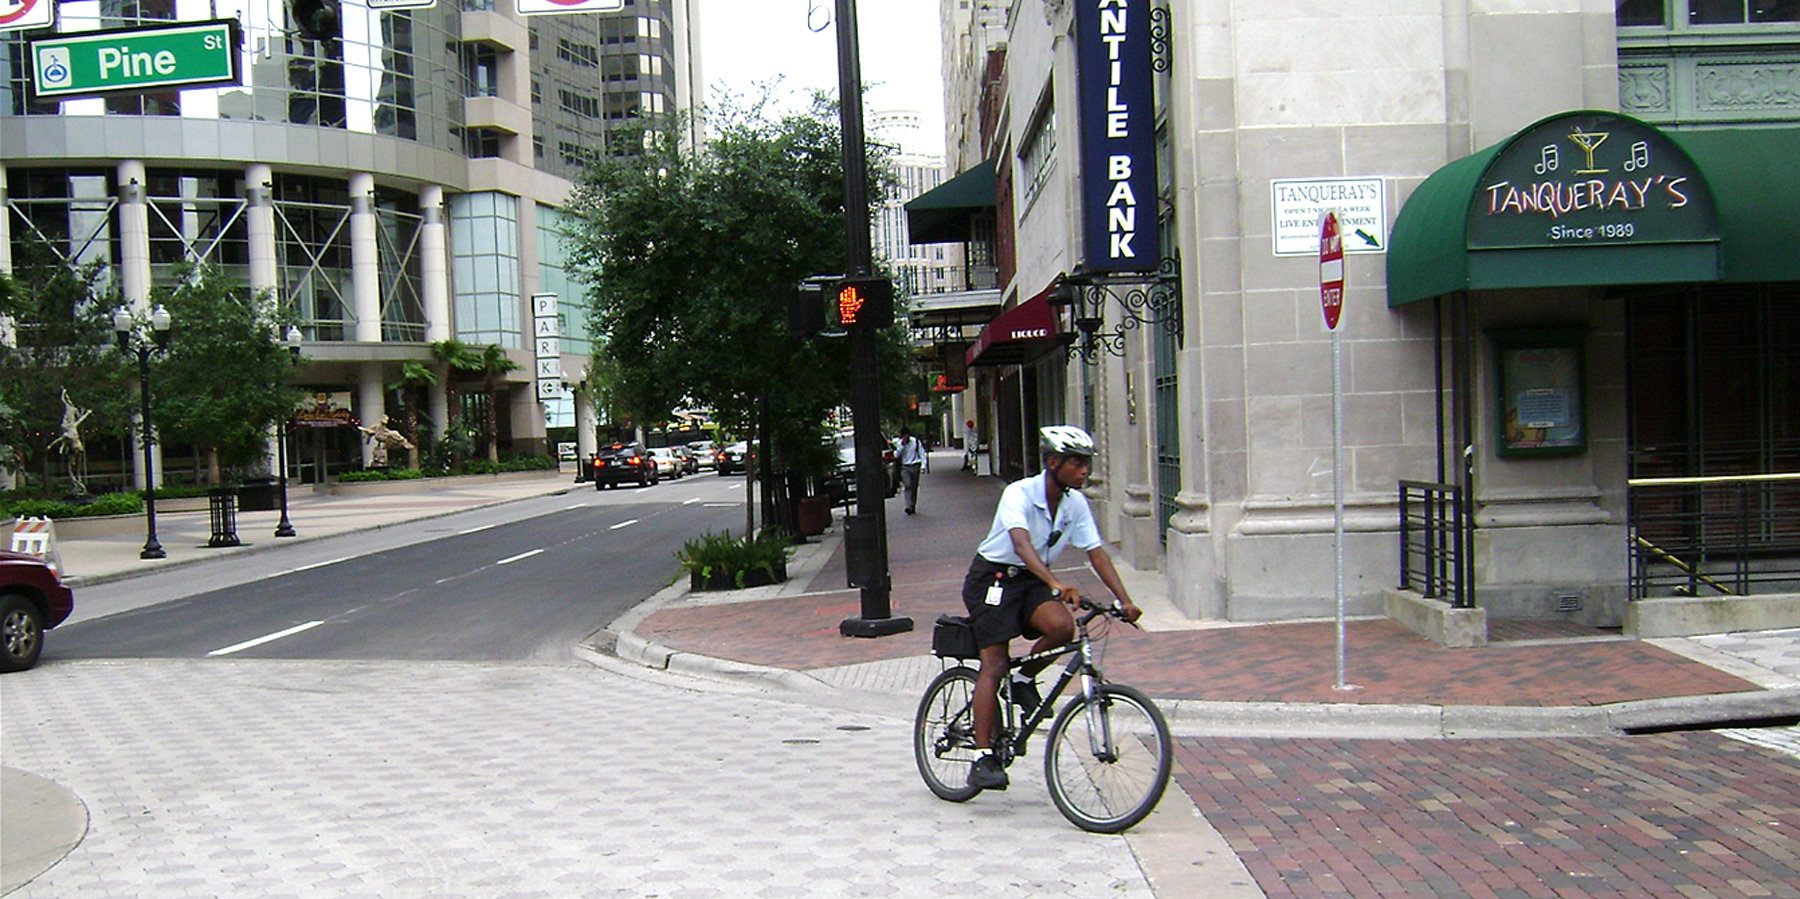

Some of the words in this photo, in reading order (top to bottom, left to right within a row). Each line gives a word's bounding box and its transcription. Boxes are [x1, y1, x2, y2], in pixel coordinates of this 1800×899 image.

[98, 46, 176, 80] Pine
[203, 34, 223, 50] St
[1106, 154, 1137, 259] BANK
[1278, 184, 1377, 203] TANQUERAY'S
[1486, 174, 1688, 221] TANQUERAY'S
[1280, 219, 1300, 228] LIVE
[1551, 224, 1593, 240] Since
[1598, 223, 1635, 239] 1989
[539, 300, 551, 374] PARK
